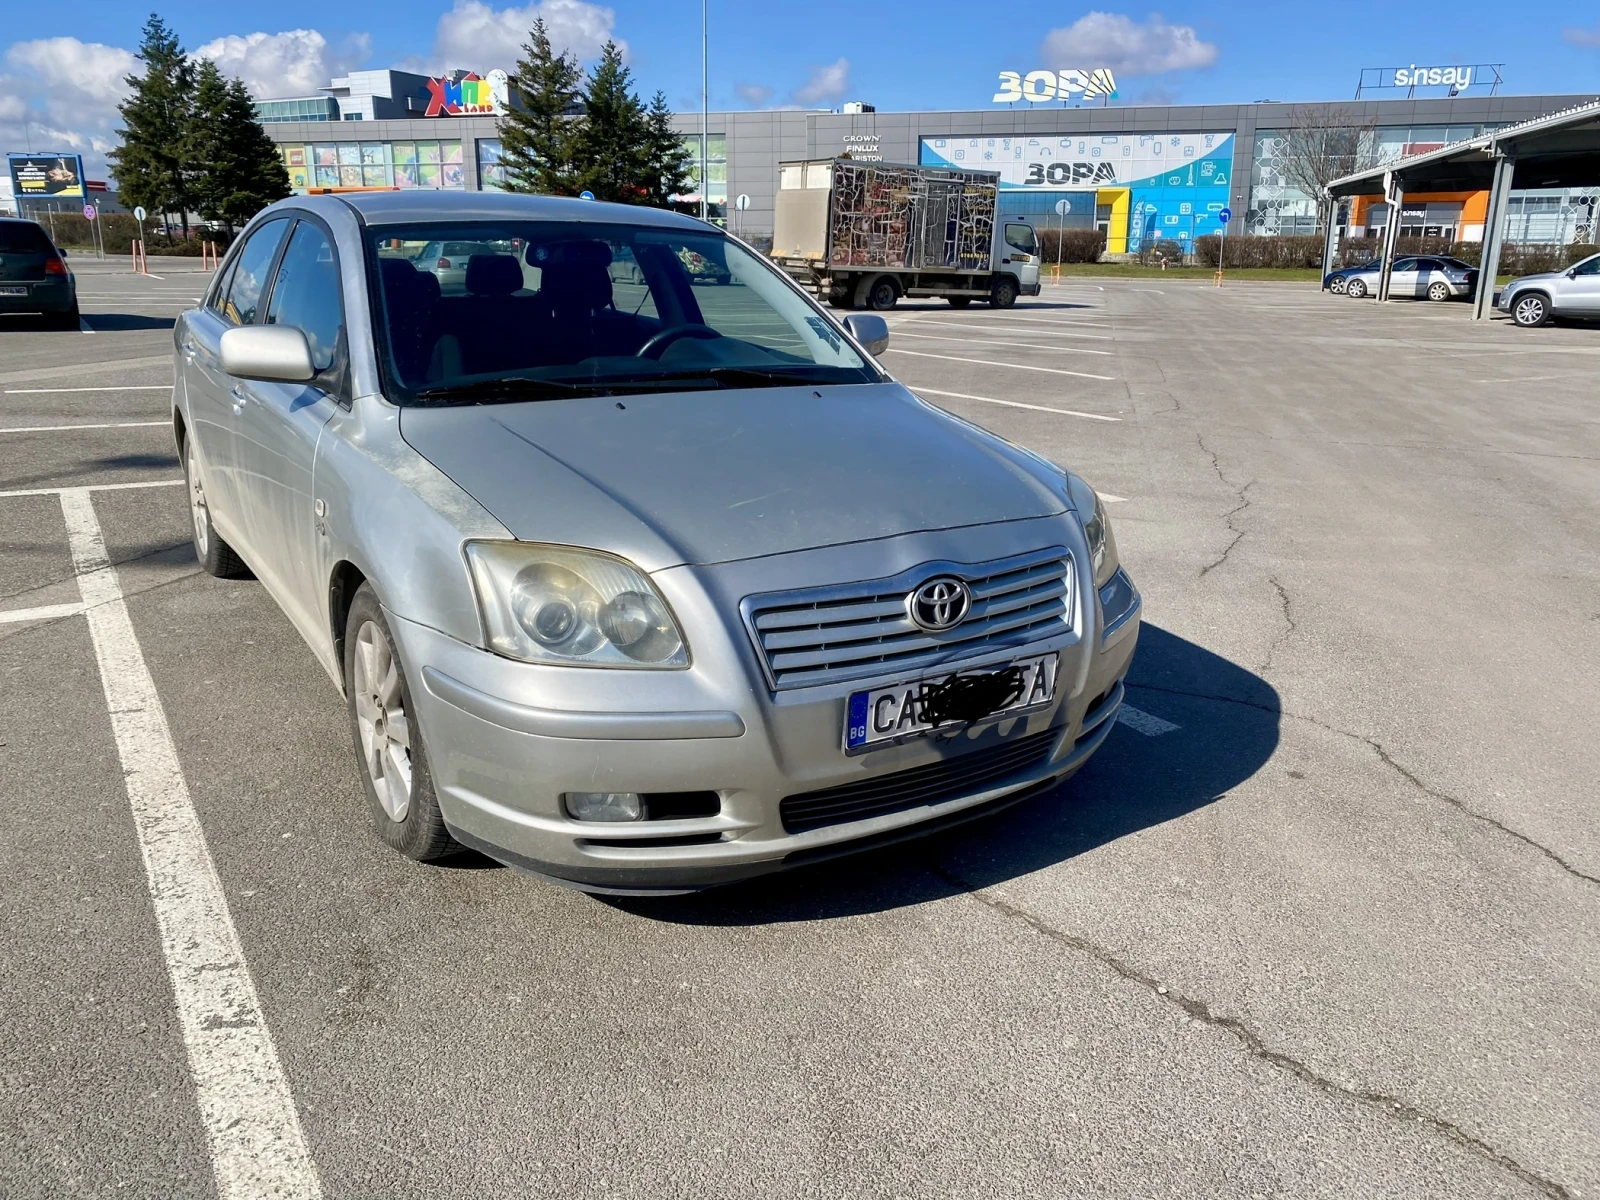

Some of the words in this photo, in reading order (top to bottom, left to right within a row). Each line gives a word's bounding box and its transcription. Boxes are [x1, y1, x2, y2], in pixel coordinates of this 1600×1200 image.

[992, 68, 1117, 103] ЗОРА
[1394, 63, 1472, 91] sinsay
[464, 103, 494, 113] LAND
[1024, 162, 1116, 185] ЗОРА
[1402, 210, 1425, 218] sinsay
[850, 725, 865, 740] BG
